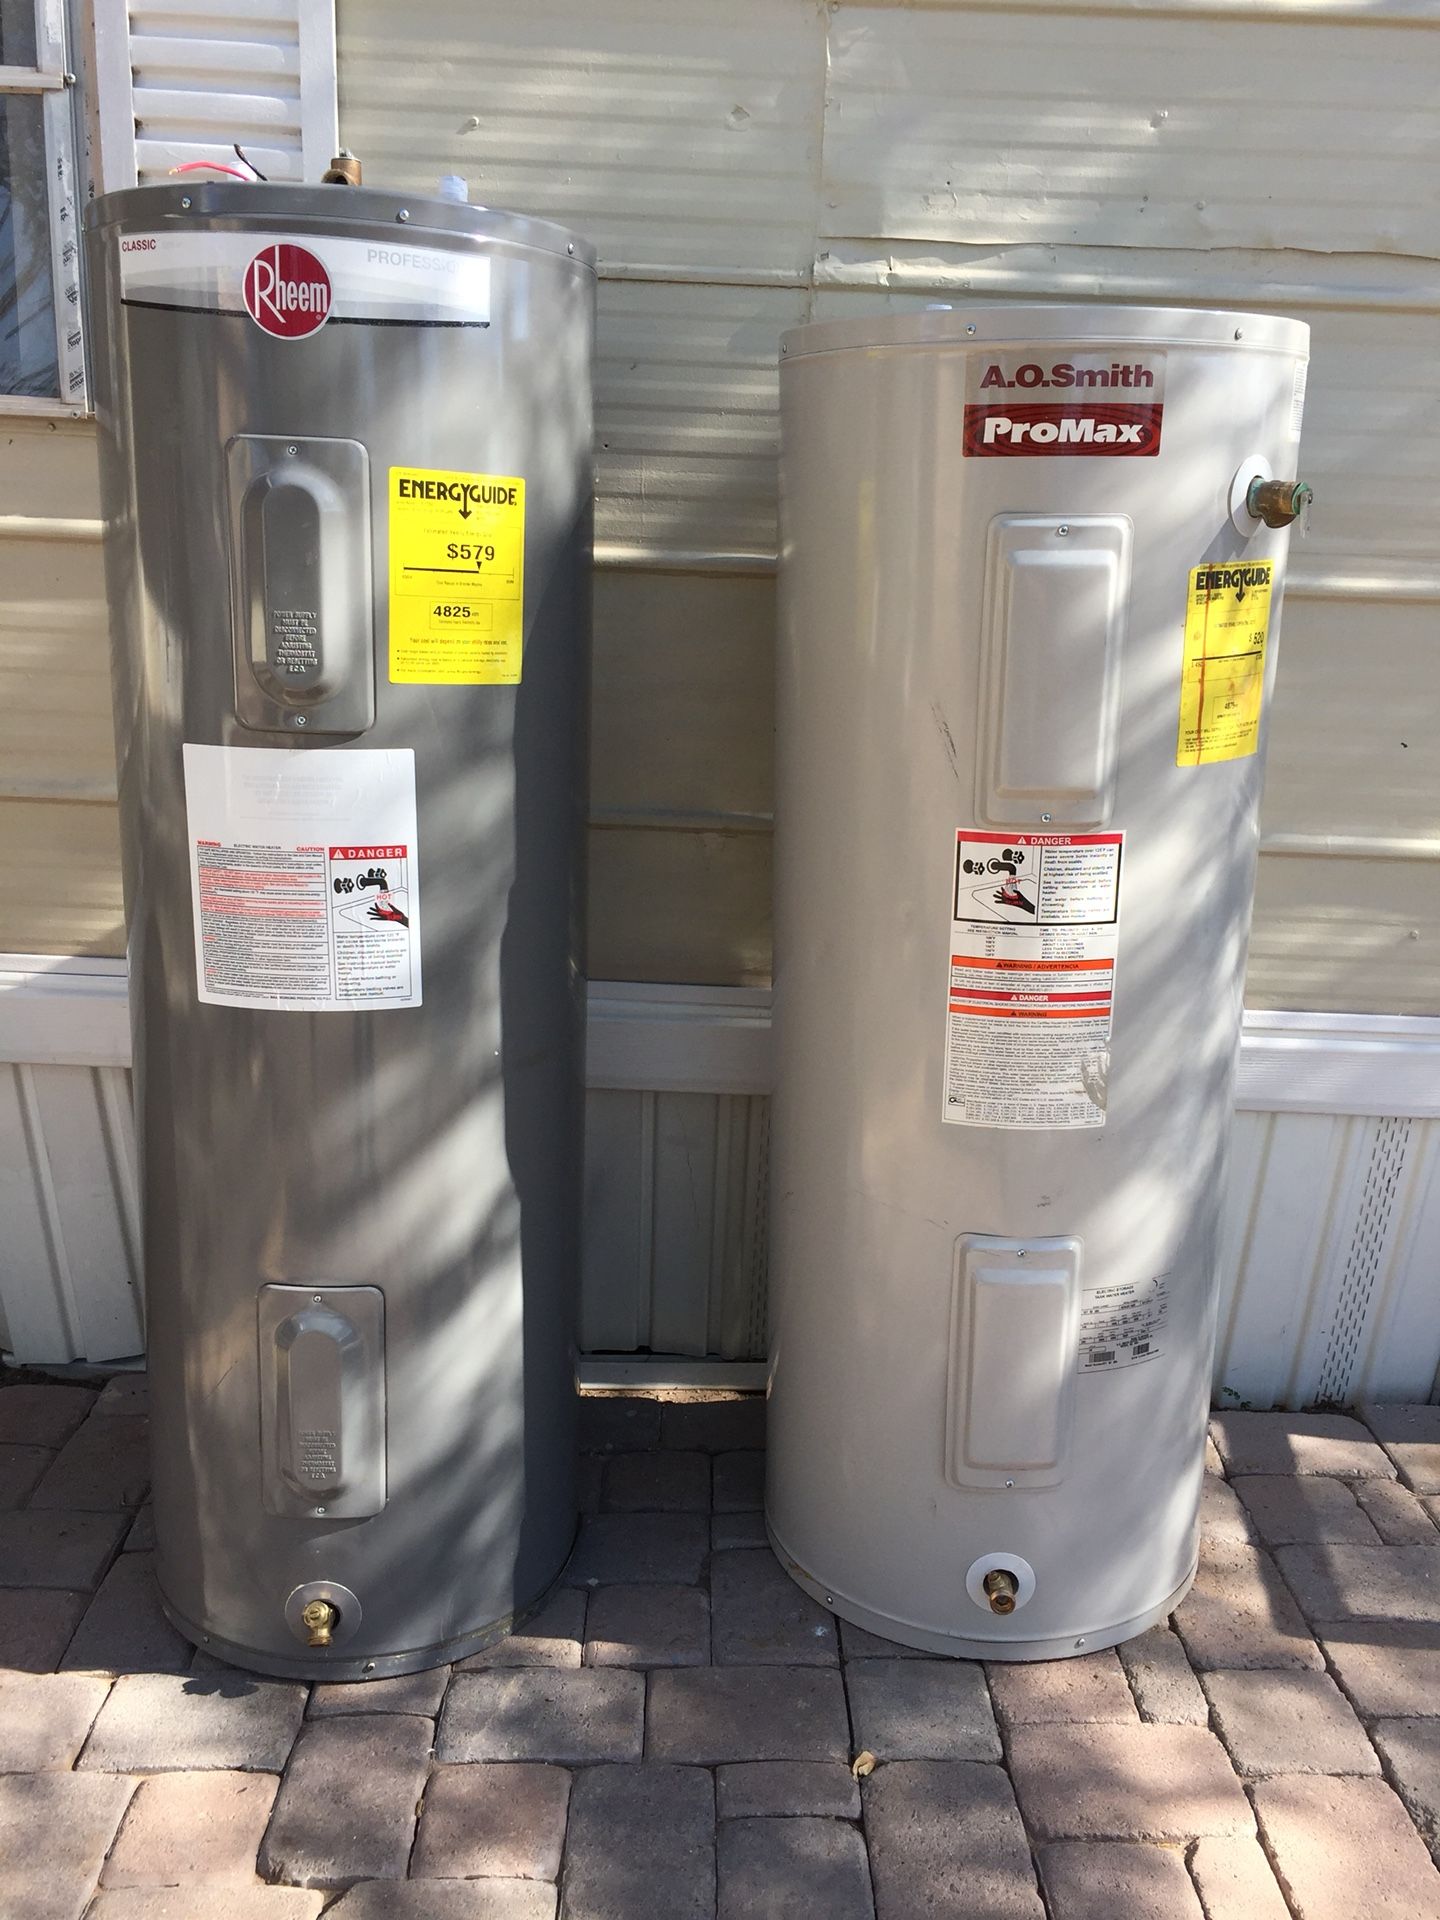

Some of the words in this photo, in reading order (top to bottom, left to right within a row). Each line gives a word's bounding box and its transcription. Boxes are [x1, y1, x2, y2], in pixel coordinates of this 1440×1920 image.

[122, 239, 156, 252] CLASSIC
[368, 248, 459, 273] PROFESSIO
[254, 245, 327, 323] Rheem
[980, 364, 1154, 388] A.O.Smith
[983, 418, 1144, 444] ProMax
[400, 478, 517, 506] ENERGYGUIDE
[446, 542, 495, 560] $579
[1196, 567, 1271, 590] ENERGYGUIDE
[434, 605, 470, 618] 4825
[1030, 837, 1072, 845] DANGER
[348, 848, 402, 858] DANGER
